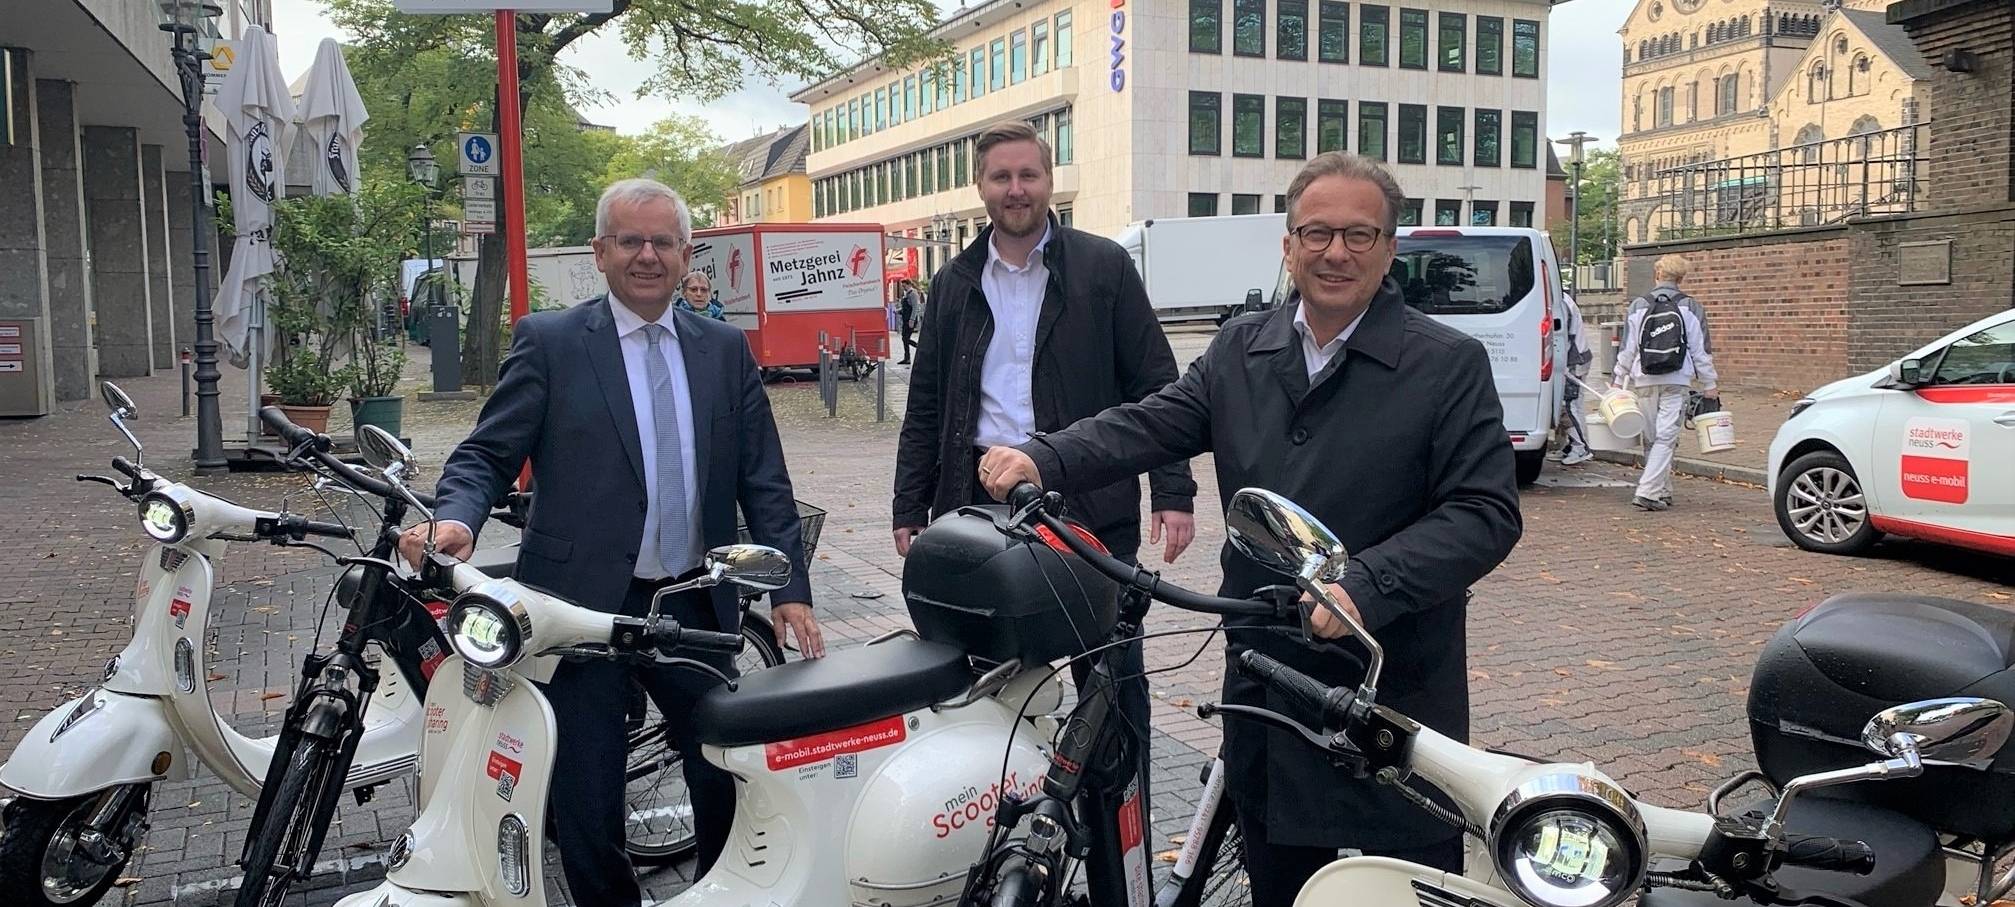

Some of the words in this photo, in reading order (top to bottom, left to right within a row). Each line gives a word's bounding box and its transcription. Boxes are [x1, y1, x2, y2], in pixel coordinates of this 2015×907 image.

[770, 250, 841, 274] Metzgerei
[800, 268, 846, 286] Jahnz
[1650, 321, 1675, 338] adidas
[1909, 427, 1964, 441] stadtwerke
[1908, 438, 1934, 448] neuss
[1903, 472, 1930, 483] neuss
[1930, 475, 1966, 488] e-mobil
[775, 727, 899, 763] e-mobil.stadtwerke-neuss.de
[798, 762, 832, 774] Einsteigen
[799, 772, 818, 781] unter:
[933, 771, 1018, 838] Scooter
[944, 785, 978, 812] mein
